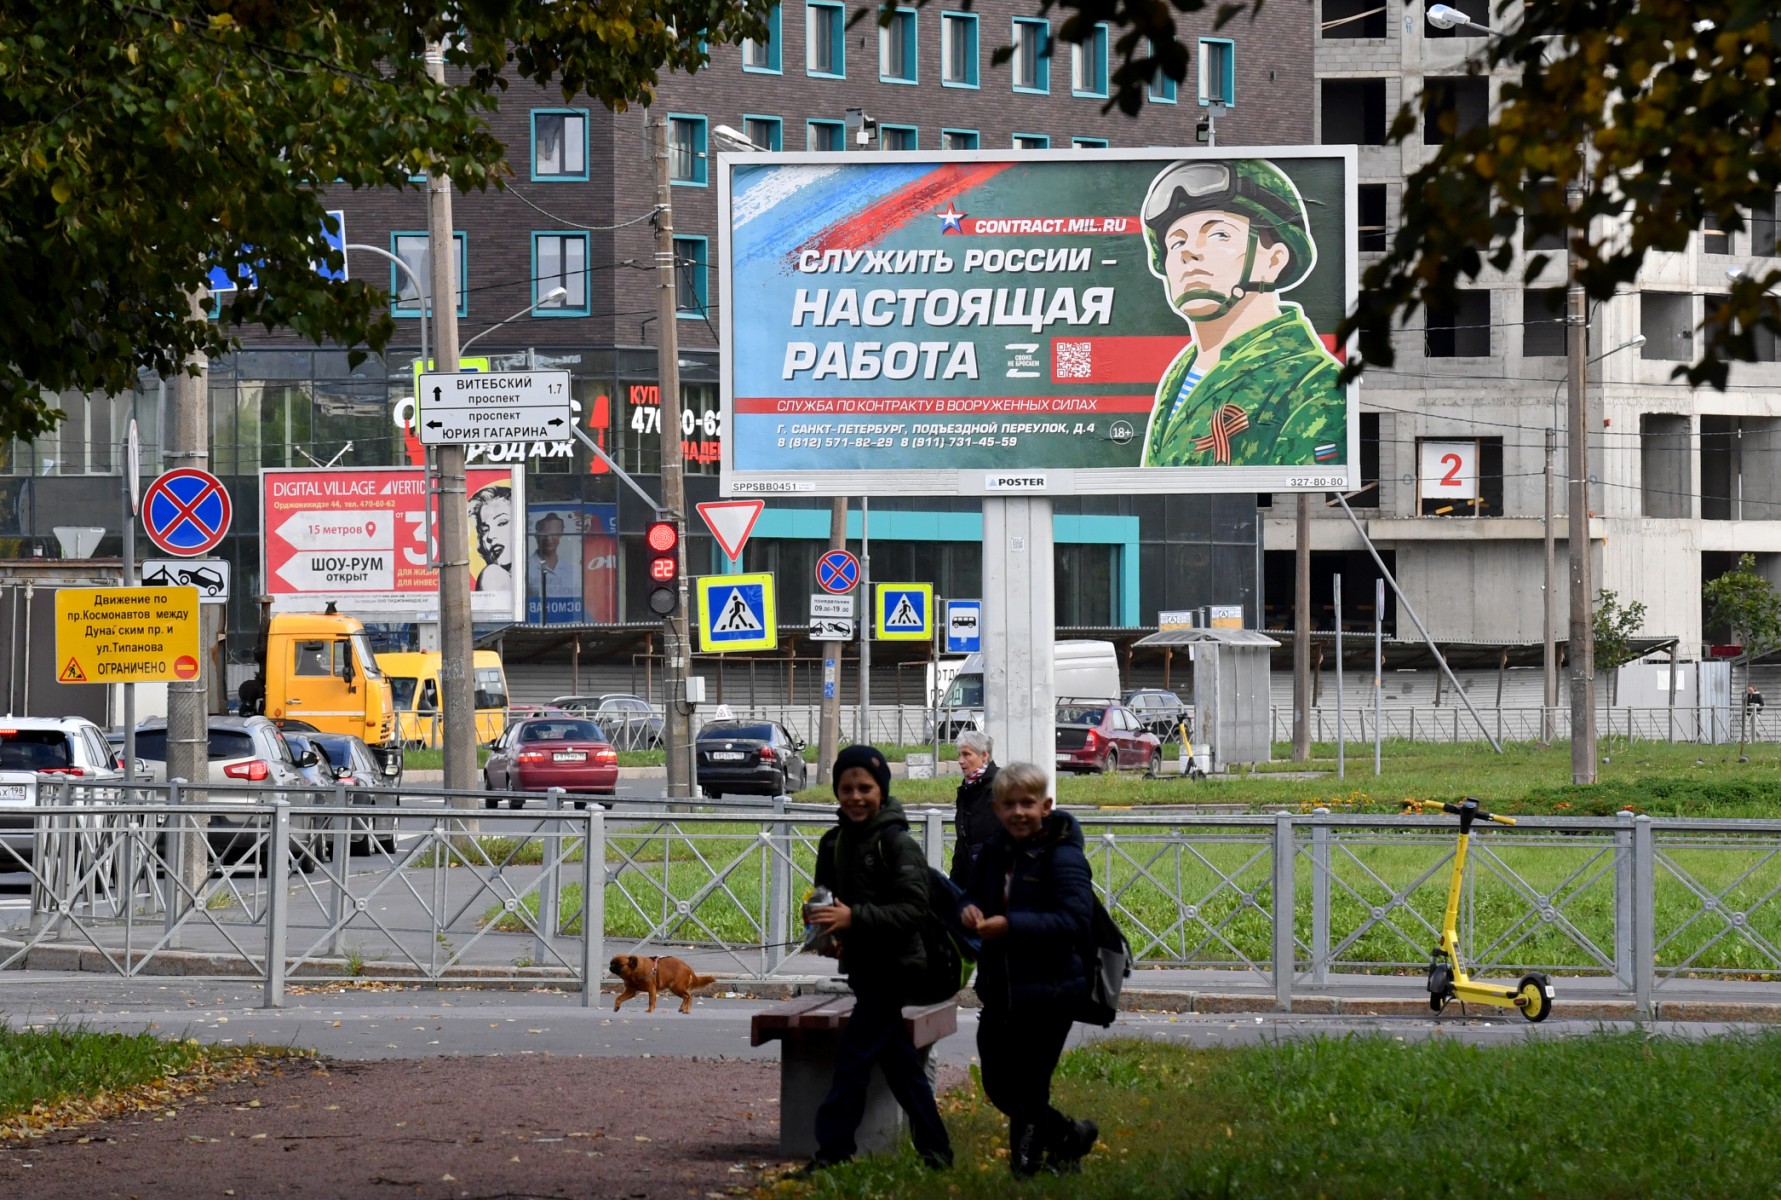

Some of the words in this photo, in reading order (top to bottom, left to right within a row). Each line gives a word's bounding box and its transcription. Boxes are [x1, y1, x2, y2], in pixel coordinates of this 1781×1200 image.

[975, 218, 1128, 234] CONTRACT.MIL.RU
[799, 248, 954, 274] СЛУЖИТЬ
[963, 247, 1093, 273] РОССИИ
[791, 286, 1115, 333] НАСТОЯЩАЯ
[782, 341, 980, 379] РАБОТА
[456, 375, 533, 391] ВИТЕБСКИЙ
[547, 383, 563, 395] 1.7
[468, 394, 521, 406] проспект
[630, 385, 661, 405] КУП
[777, 400, 834, 412] СЛУЖБА
[836, 400, 856, 412] ПО
[857, 399, 936, 412] КОНТРАКТУ
[936, 399, 945, 411] В
[947, 399, 1050, 412] ВООРУЖЕННЫХ
[1051, 399, 1098, 411] СИЛАХ
[468, 411, 521, 423] проспект
[442, 428, 480, 440] ЮРИЯ
[484, 426, 548, 438] ГАГАРИНА
[777, 424, 787, 434] Г.
[791, 423, 908, 436] САНКТ-ПЕТЕРБУРГ,
[912, 422, 999, 435] ПОДЪЕЗДНОЙ
[1001, 423, 1070, 435] ПЕРЕУЛОК,
[1073, 422, 1096, 435] Д.4
[1112, 427, 1132, 439] 18+
[777, 437, 786, 448] 8
[789, 437, 821, 449] (812)
[825, 437, 894, 448] 571-82-29
[900, 437, 909, 448] 8
[912, 437, 945, 449] (911)
[949, 436, 1018, 448] 731-45-59
[464, 439, 576, 465] РОДАЖ
[1439, 452, 1463, 487] 2
[273, 481, 322, 497] DIGITAL
[323, 480, 377, 496] VILLAGE
[391, 479, 436, 495] VERTIC
[732, 482, 797, 492] SPPSBB0451
[998, 478, 1045, 487] POSTER
[1290, 477, 1343, 487] 327-80-80
[273, 500, 329, 511] Орджоникидзе
[360, 499, 396, 508] 470-60-62
[308, 525, 320, 535] 15
[322, 527, 363, 539] метров
[311, 556, 384, 572] ШОУ-РУМ
[654, 560, 674, 577] 22
[326, 572, 369, 585] открыт
[397, 568, 412, 577] ДЛЯ
[397, 578, 412, 588] ДЛЯ
[413, 578, 438, 587] ИНВЕС
[94, 594, 151, 607] Движение
[154, 595, 168, 604] по
[67, 610, 151, 623] пр.Космонавтов
[156, 610, 189, 621] между
[147, 627, 164, 637] пр.
[167, 625, 174, 634] и
[96, 642, 164, 656] ул.Типанова
[97, 661, 166, 675] ОГРАНИЧЕНО
